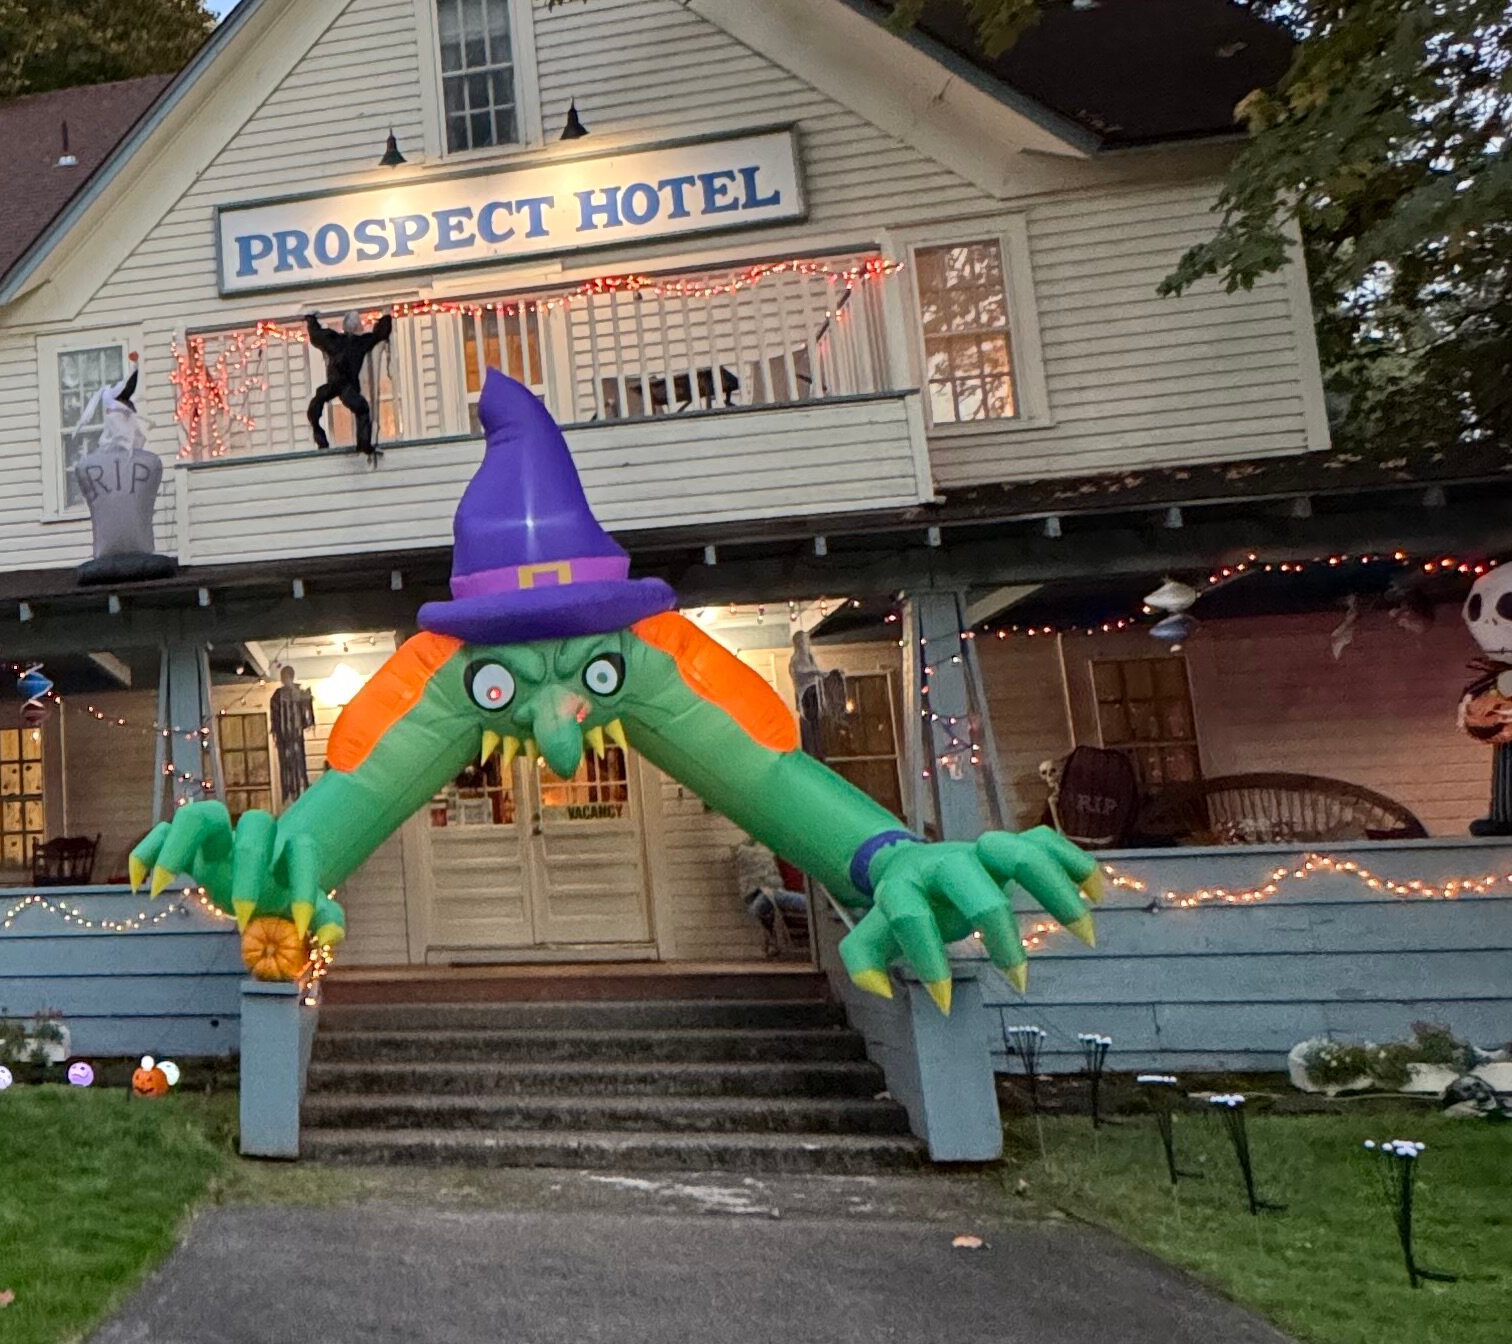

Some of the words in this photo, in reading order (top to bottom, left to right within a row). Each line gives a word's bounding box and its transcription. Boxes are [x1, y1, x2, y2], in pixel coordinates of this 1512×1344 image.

[235, 196, 554, 278] PROSPECT
[574, 166, 782, 232] HOTEL
[85, 459, 152, 499] RIP
[568, 805, 624, 821] VACANCY
[1075, 794, 1118, 815] RIP
